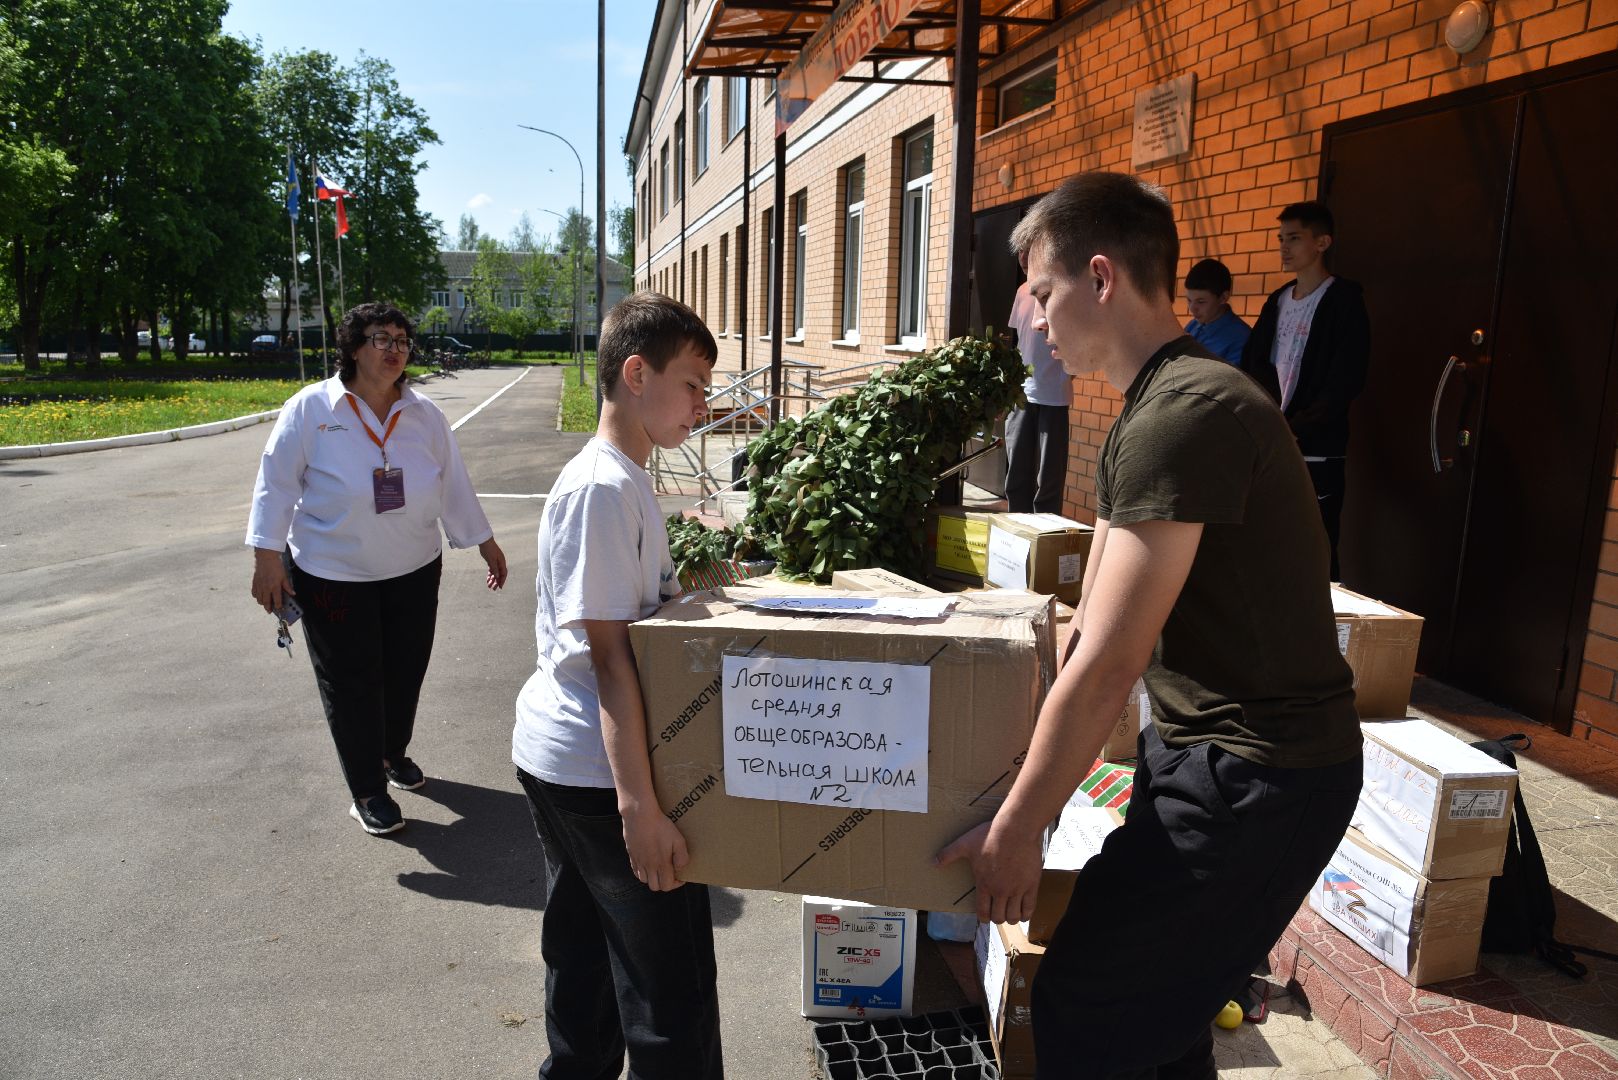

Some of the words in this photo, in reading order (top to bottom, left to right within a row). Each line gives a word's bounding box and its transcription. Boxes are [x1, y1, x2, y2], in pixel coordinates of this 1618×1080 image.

[731, 667, 893, 695] Лотошинская
[751, 698, 841, 718] средняя
[837, 946, 862, 956] ZIC
